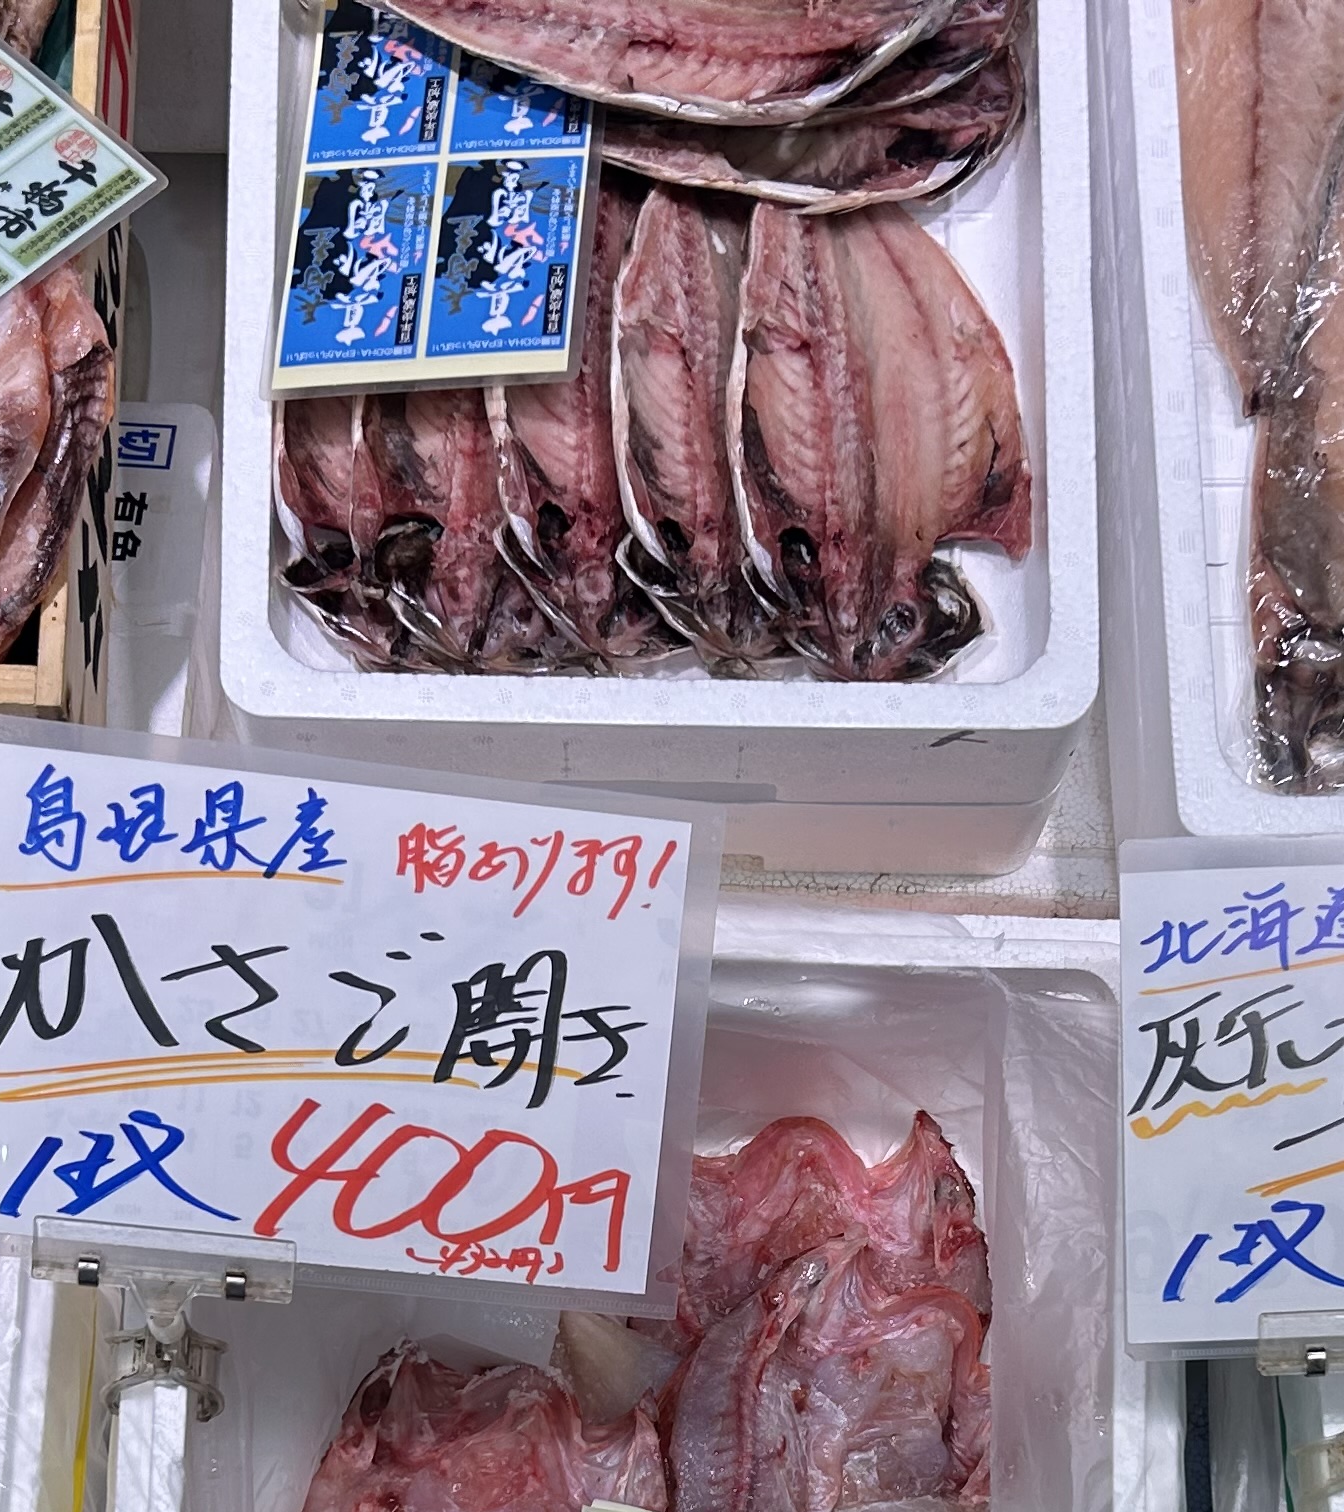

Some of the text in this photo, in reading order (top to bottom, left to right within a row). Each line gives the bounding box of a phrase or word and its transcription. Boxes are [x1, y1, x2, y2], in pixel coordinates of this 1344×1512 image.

[19, 765, 348, 878] 島根県産
[255, 1098, 631, 1273] 400円
